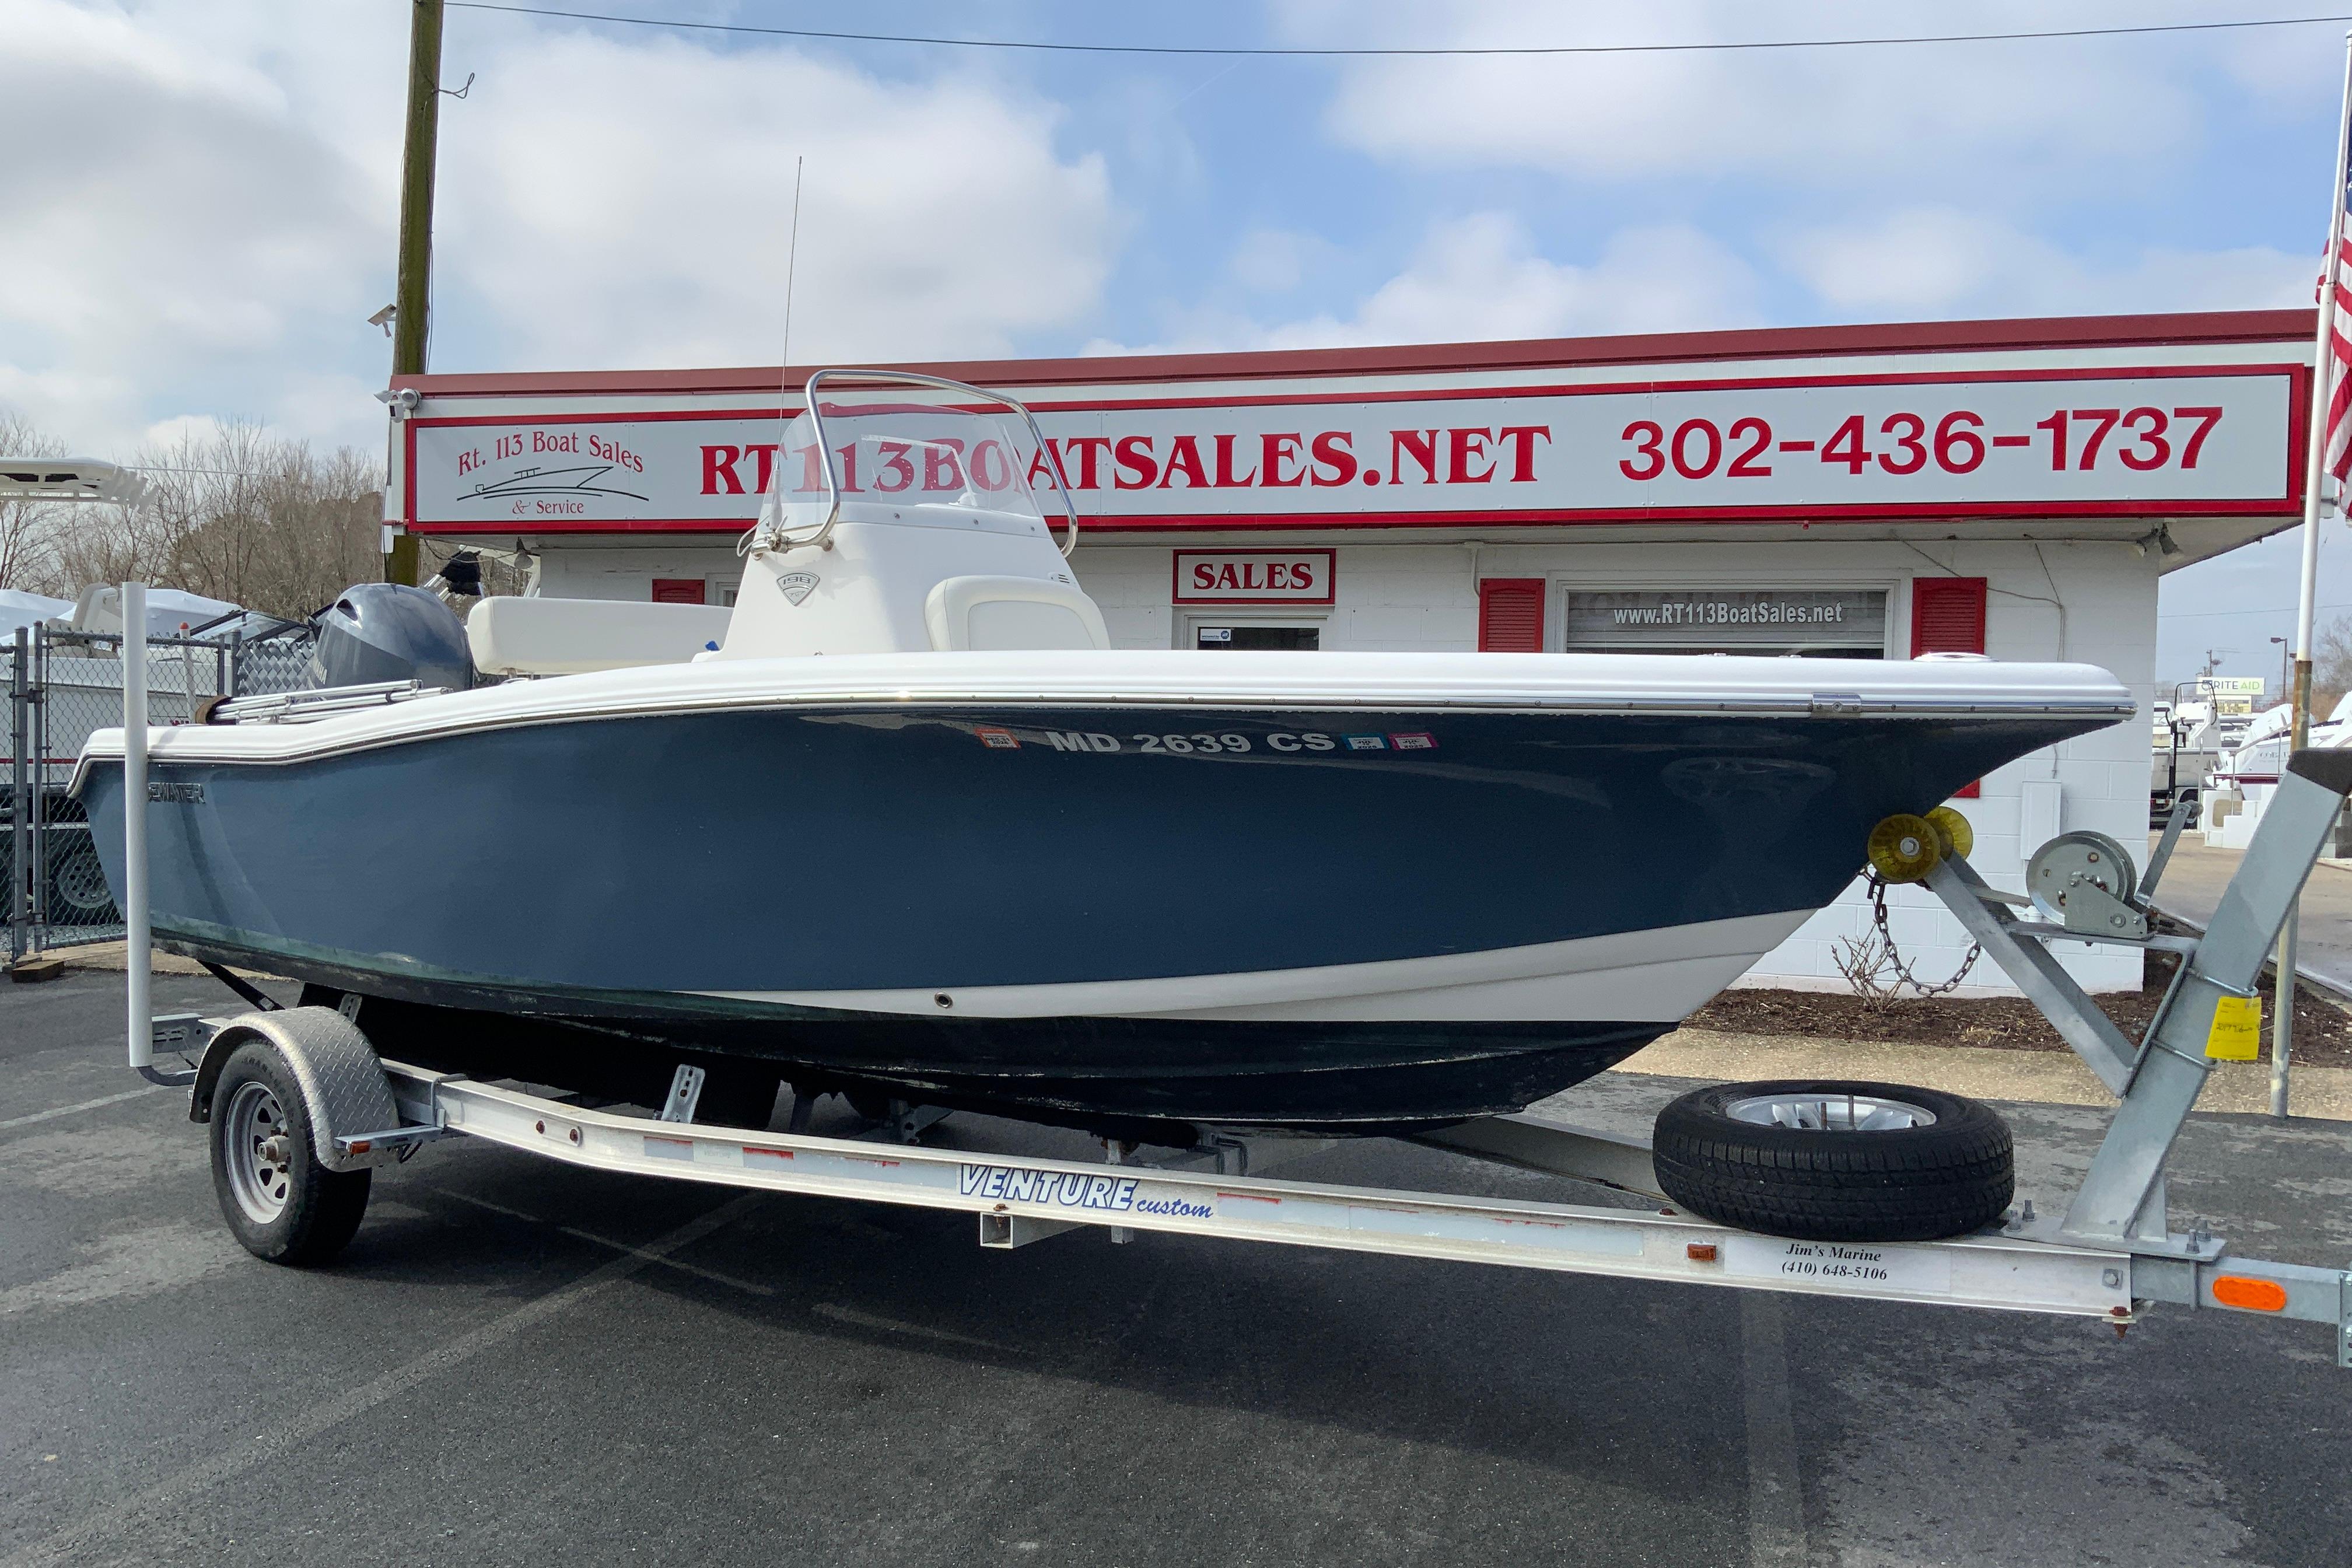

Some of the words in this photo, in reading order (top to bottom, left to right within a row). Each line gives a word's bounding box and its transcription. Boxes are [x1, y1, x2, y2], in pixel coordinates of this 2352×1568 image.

[459, 448, 486, 477] Rt.
[496, 433, 523, 460] 113
[533, 430, 579, 454] Boat
[589, 434, 643, 473] Sales
[700, 425, 1552, 495] RT113BOATSALES.NET
[1619, 407, 2222, 481] 302-436-1737
[512, 500, 530, 514] &
[536, 499, 584, 514] Service
[783, 576, 811, 585] 198
[1194, 563, 1314, 590] SALES
[1614, 602, 1843, 624] www.RT113BoatSales.net
[2214, 681, 2239, 690] RITE
[2241, 681, 2260, 690] AID
[1046, 732, 1121, 752] MD
[1133, 734, 1251, 753] 2639
[1266, 733, 1336, 752] CS
[961, 1164, 1140, 1211] VENTURE
[1136, 1199, 1214, 1219] custom
[1786, 1243, 1825, 1258] Jim's
[1829, 1246, 1882, 1262] Marine
[1782, 1261, 1817, 1276] (410)
[1822, 1264, 1888, 1280] 648-5106
